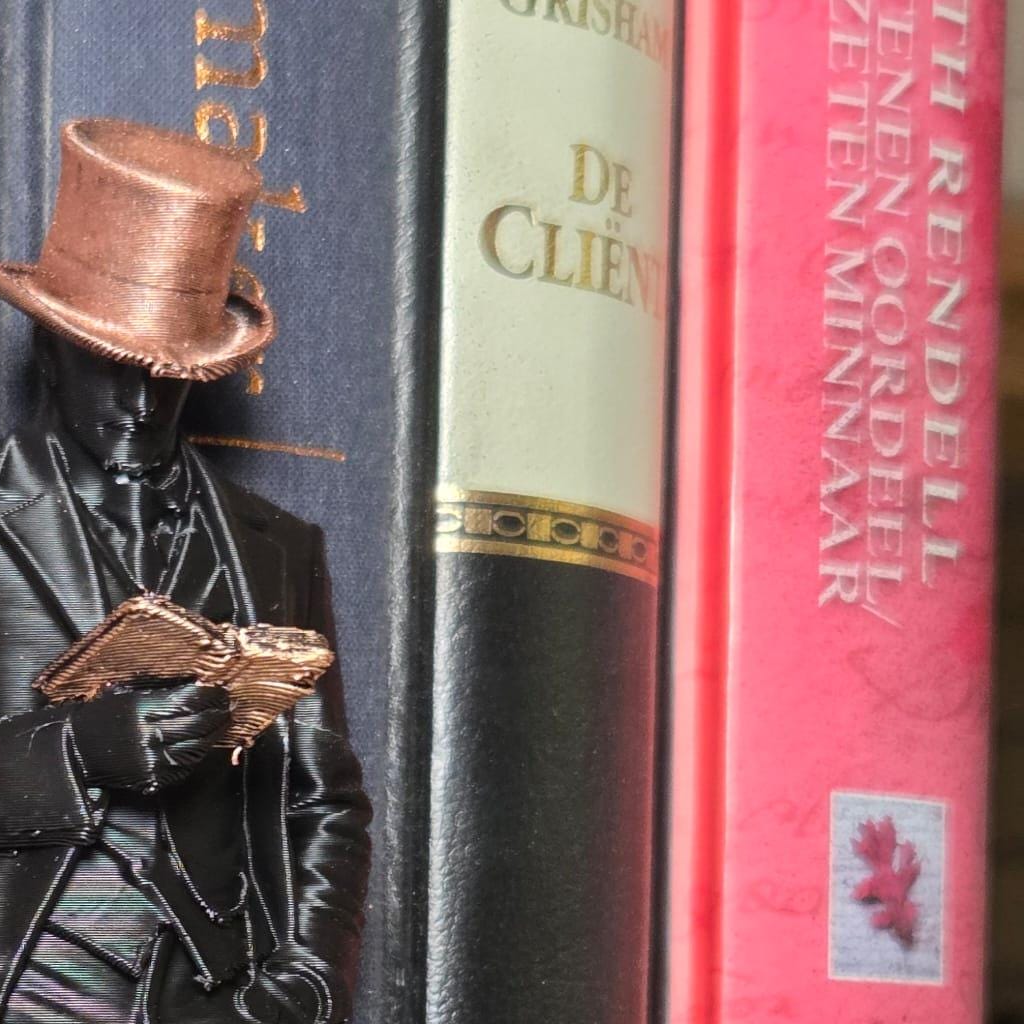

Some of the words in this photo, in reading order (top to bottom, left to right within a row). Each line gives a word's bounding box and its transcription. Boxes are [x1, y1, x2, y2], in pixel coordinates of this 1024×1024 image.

[568, 143, 633, 219] DE
[874, 0, 914, 218] ENEN
[817, 241, 867, 608] MINNAAR
[921, 137, 965, 589] RENDELL
